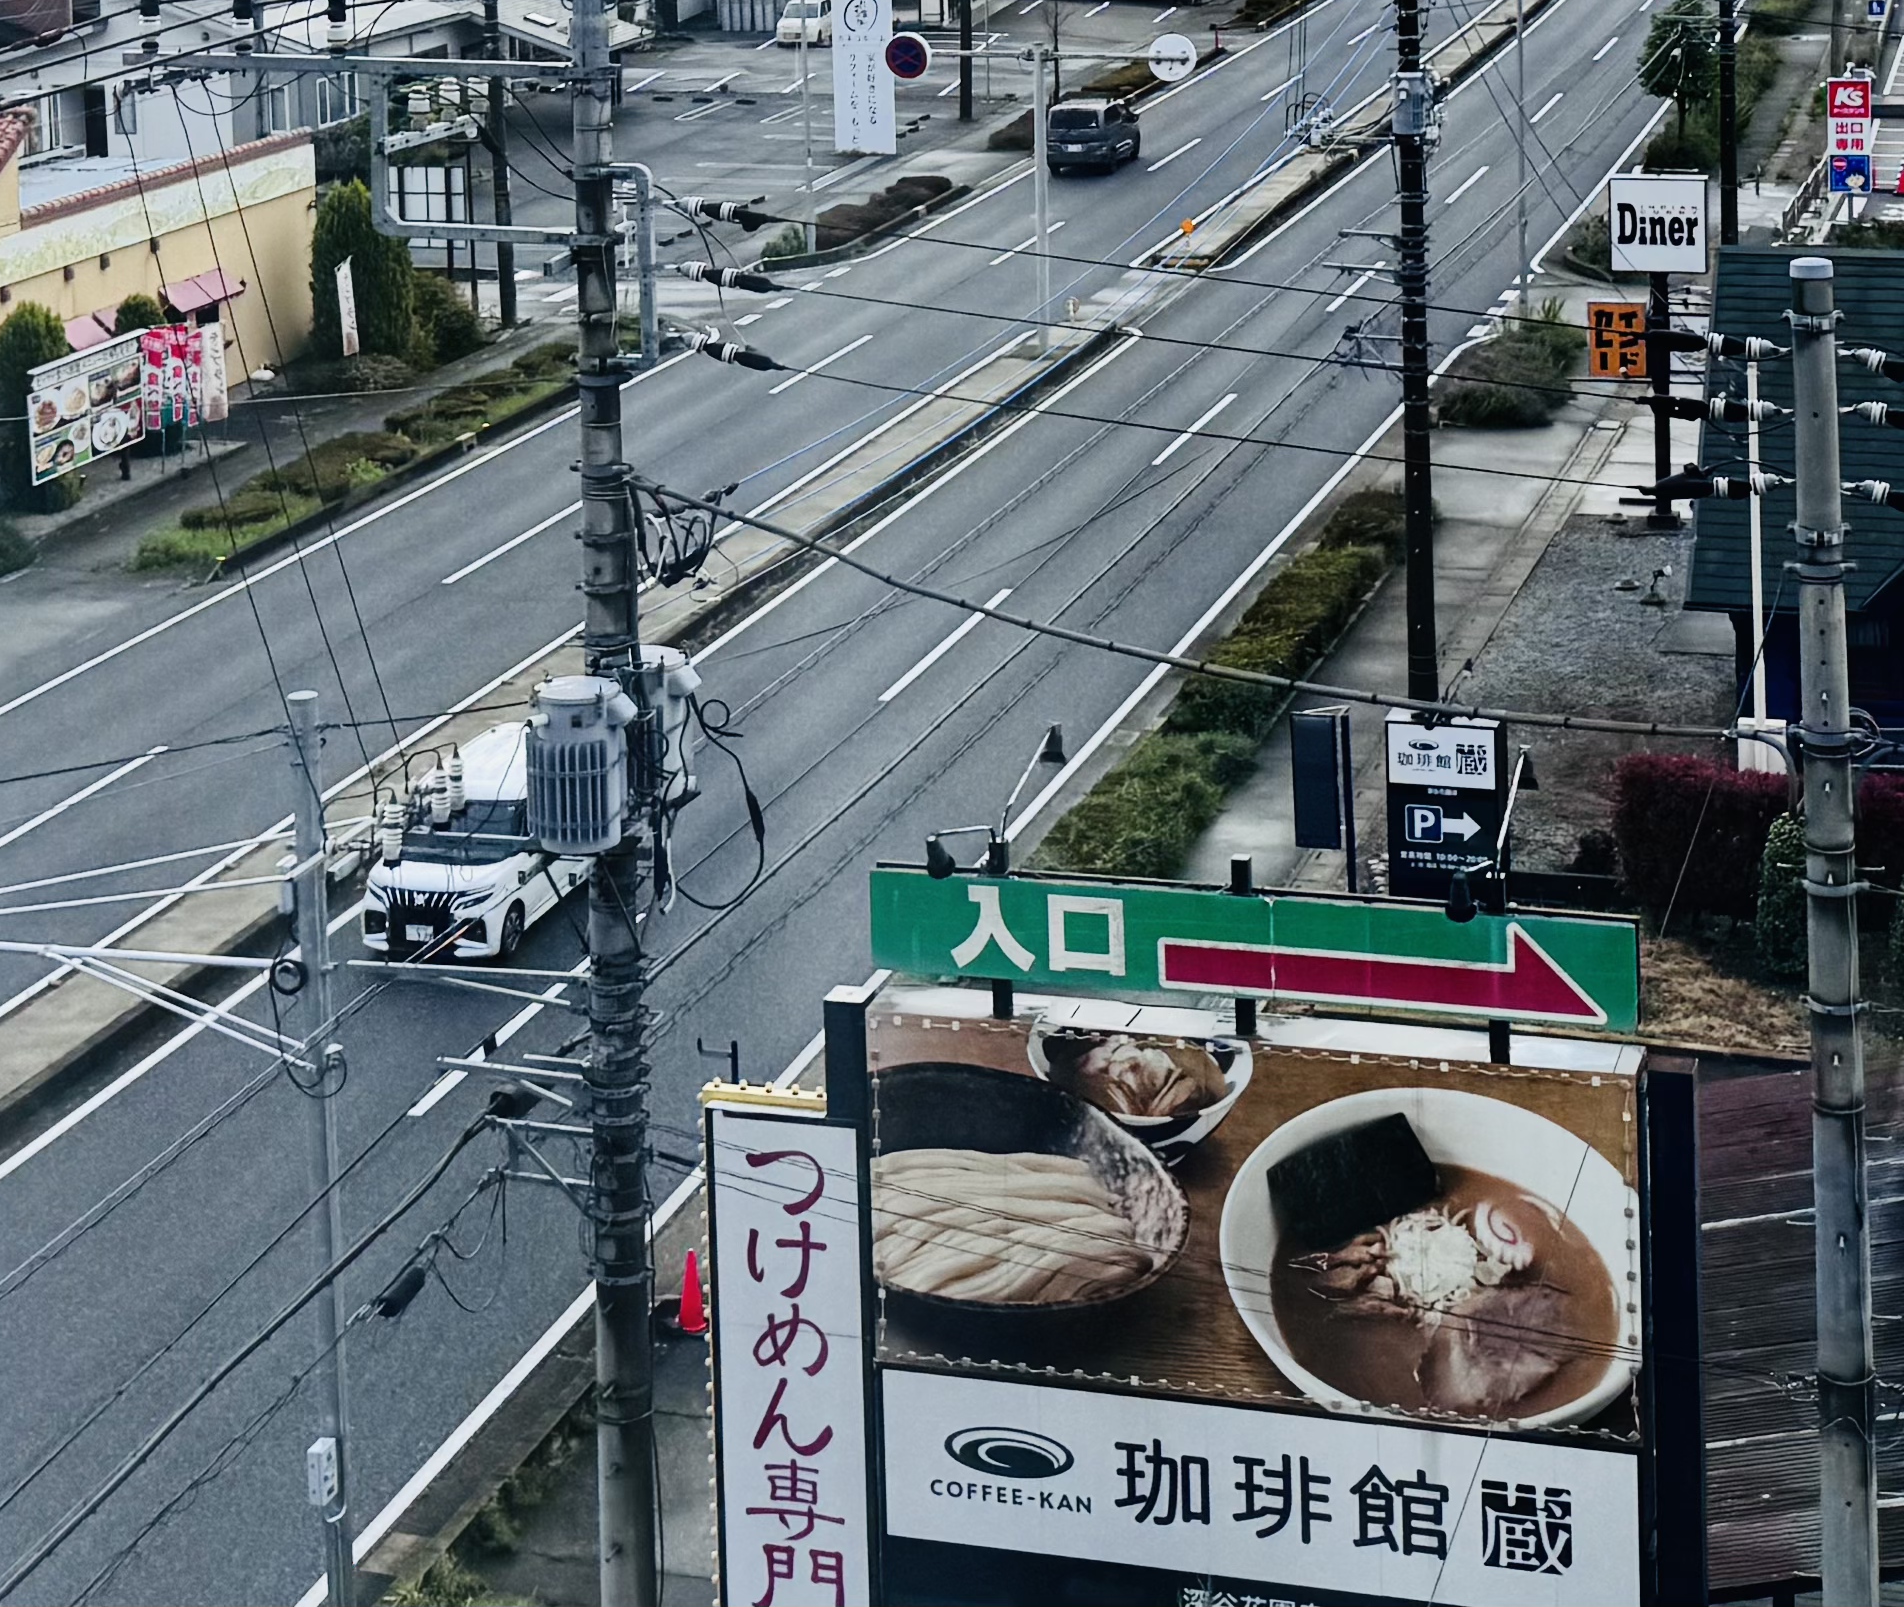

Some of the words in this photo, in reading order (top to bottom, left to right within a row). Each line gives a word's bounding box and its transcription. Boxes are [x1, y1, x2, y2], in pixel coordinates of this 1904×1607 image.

[1836, 122, 1864, 134] 出口
[1617, 203, 1698, 246] Diner
[1397, 752, 1451, 769] 珈琲館
[1414, 809, 1435, 838] P
[950, 884, 1126, 976] 入口
[746, 1149, 845, 1607] つけめん専門
[930, 1478, 1092, 1514] COFFEE-KAN
[1114, 1438, 1449, 1561] 珈琲館
